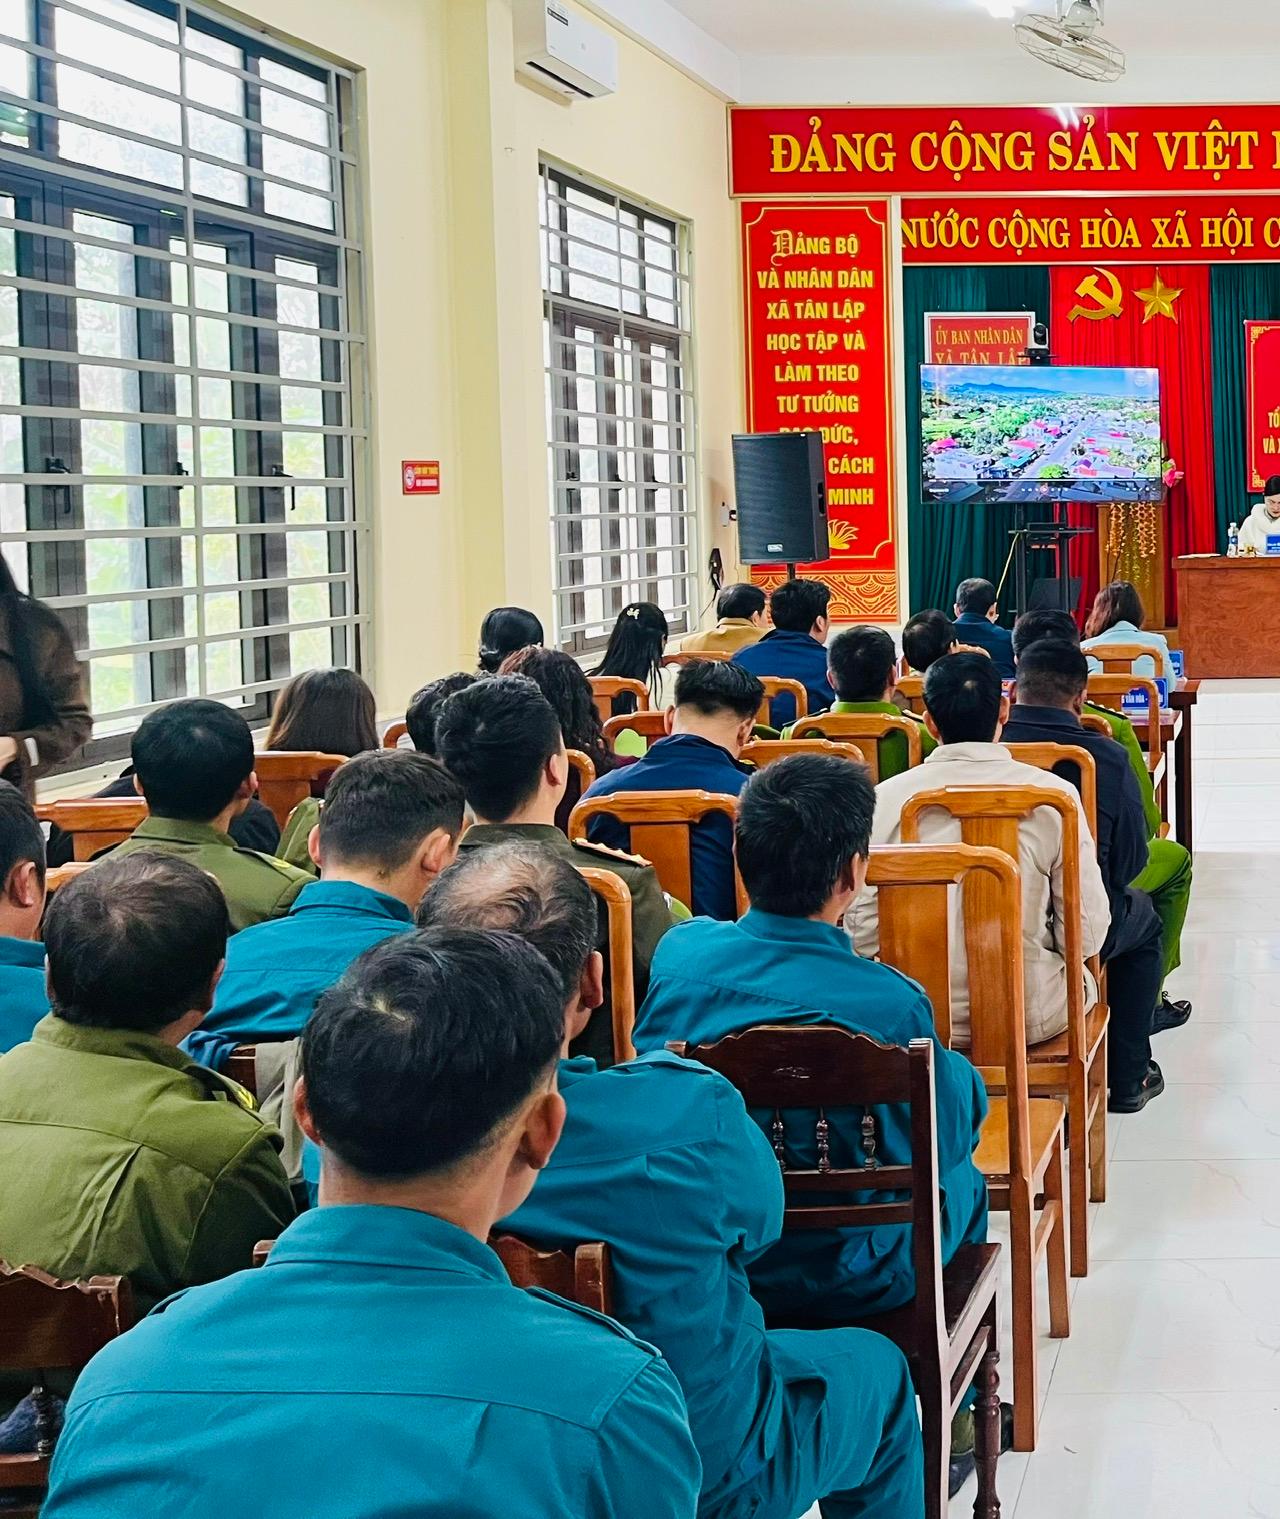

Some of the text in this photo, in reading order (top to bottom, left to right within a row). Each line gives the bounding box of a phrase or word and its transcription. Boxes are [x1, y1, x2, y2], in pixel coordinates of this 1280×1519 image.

[770, 116, 896, 172] ĐẢNG
[911, 120, 1035, 181] CỘNG
[1048, 114, 1138, 170] SẢN
[1153, 120, 1258, 180] VIỆT
[901, 208, 979, 248] NƯỚC
[988, 209, 1070, 255] CỘNG
[1080, 209, 1141, 247] HÒA
[1152, 210, 1191, 247] XÃ
[1200, 208, 1254, 255] HỘI
[771, 230, 859, 265] ĐẢNG BỘ
[756, 266, 874, 289] VÀ NHÂN DÂN
[766, 298, 865, 323] XÃ TÂN LẬP
[766, 329, 866, 354] HỌC TẬP VÀ
[935, 324, 1023, 345] ỦY BAN NHÂN DÂN
[959, 347, 990, 364] TÂN
[774, 361, 859, 382] LÀM THEO
[776, 390, 859, 413] TƯ TƯỞNG
[821, 423, 859, 446] ĐỨC,
[1262, 435, 1276, 454] VÀ
[828, 454, 874, 475] CÁCH
[828, 488, 874, 506] MINH
